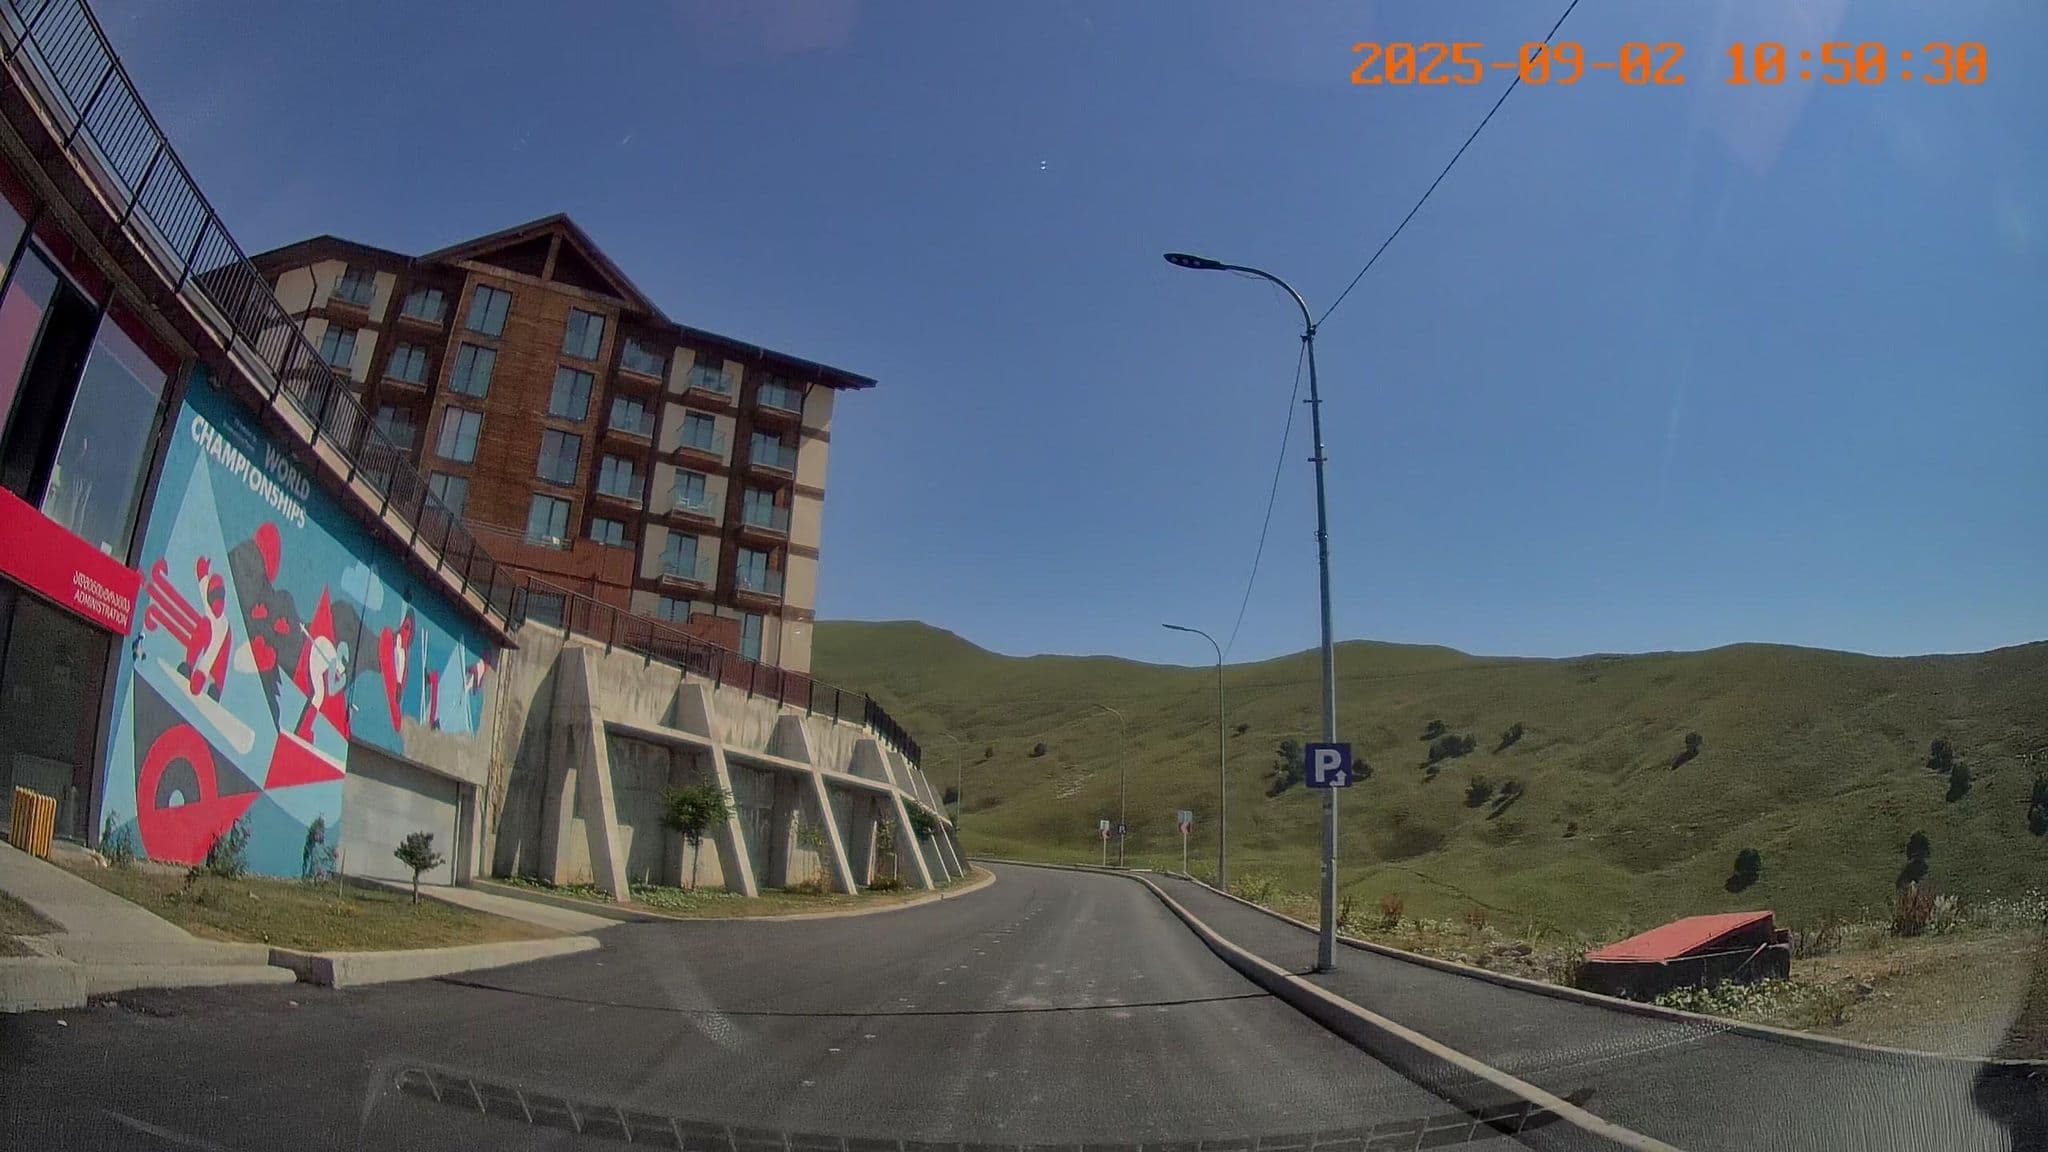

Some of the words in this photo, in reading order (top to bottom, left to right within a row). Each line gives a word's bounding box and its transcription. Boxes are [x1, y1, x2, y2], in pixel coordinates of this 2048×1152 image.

[191, 415, 307, 529] CHAMPIONSHIPS
[265, 442, 310, 501] WORLD
[74, 589, 128, 628] ADMINISTRATION
[1315, 749, 1341, 782] P
